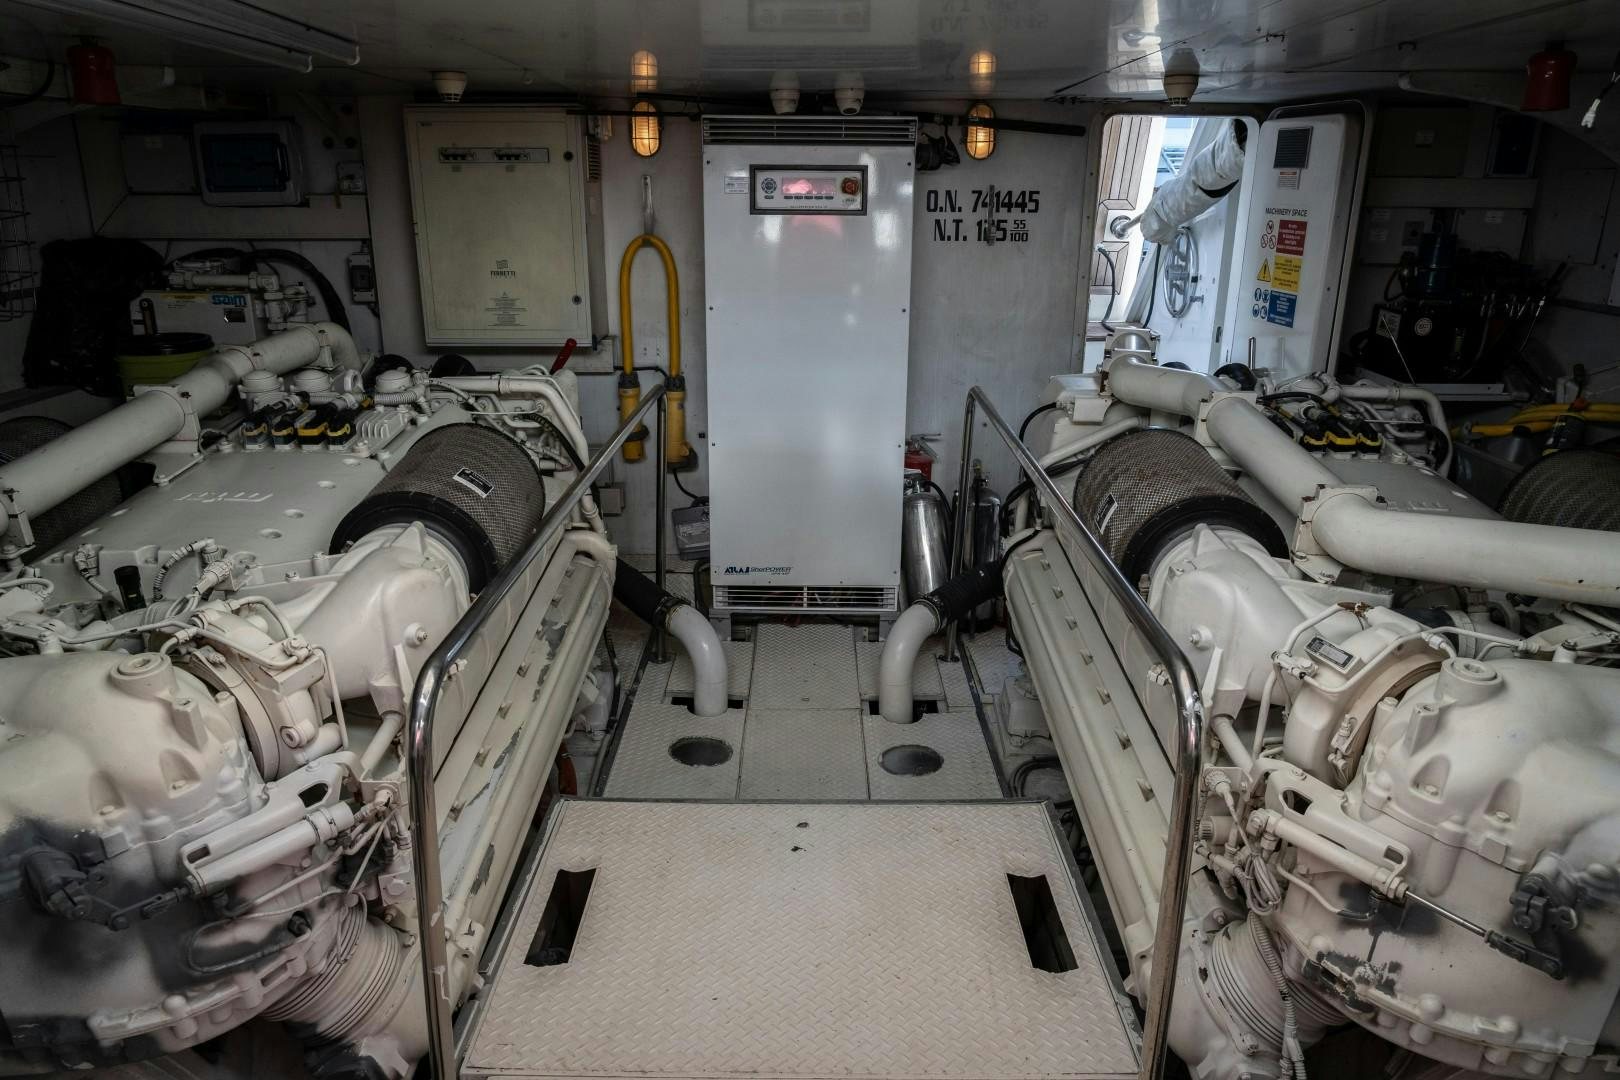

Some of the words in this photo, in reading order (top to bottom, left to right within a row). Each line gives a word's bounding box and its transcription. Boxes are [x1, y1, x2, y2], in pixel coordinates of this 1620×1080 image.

[927, 189, 962, 213] O.N.
[972, 189, 1041, 213] 741445
[1265, 207, 1292, 216] MACHINERY
[1292, 208, 1308, 217] SPACE
[1014, 219, 1027, 230] 55
[935, 219, 968, 242] N.T.
[1010, 232, 1029, 242] 100
